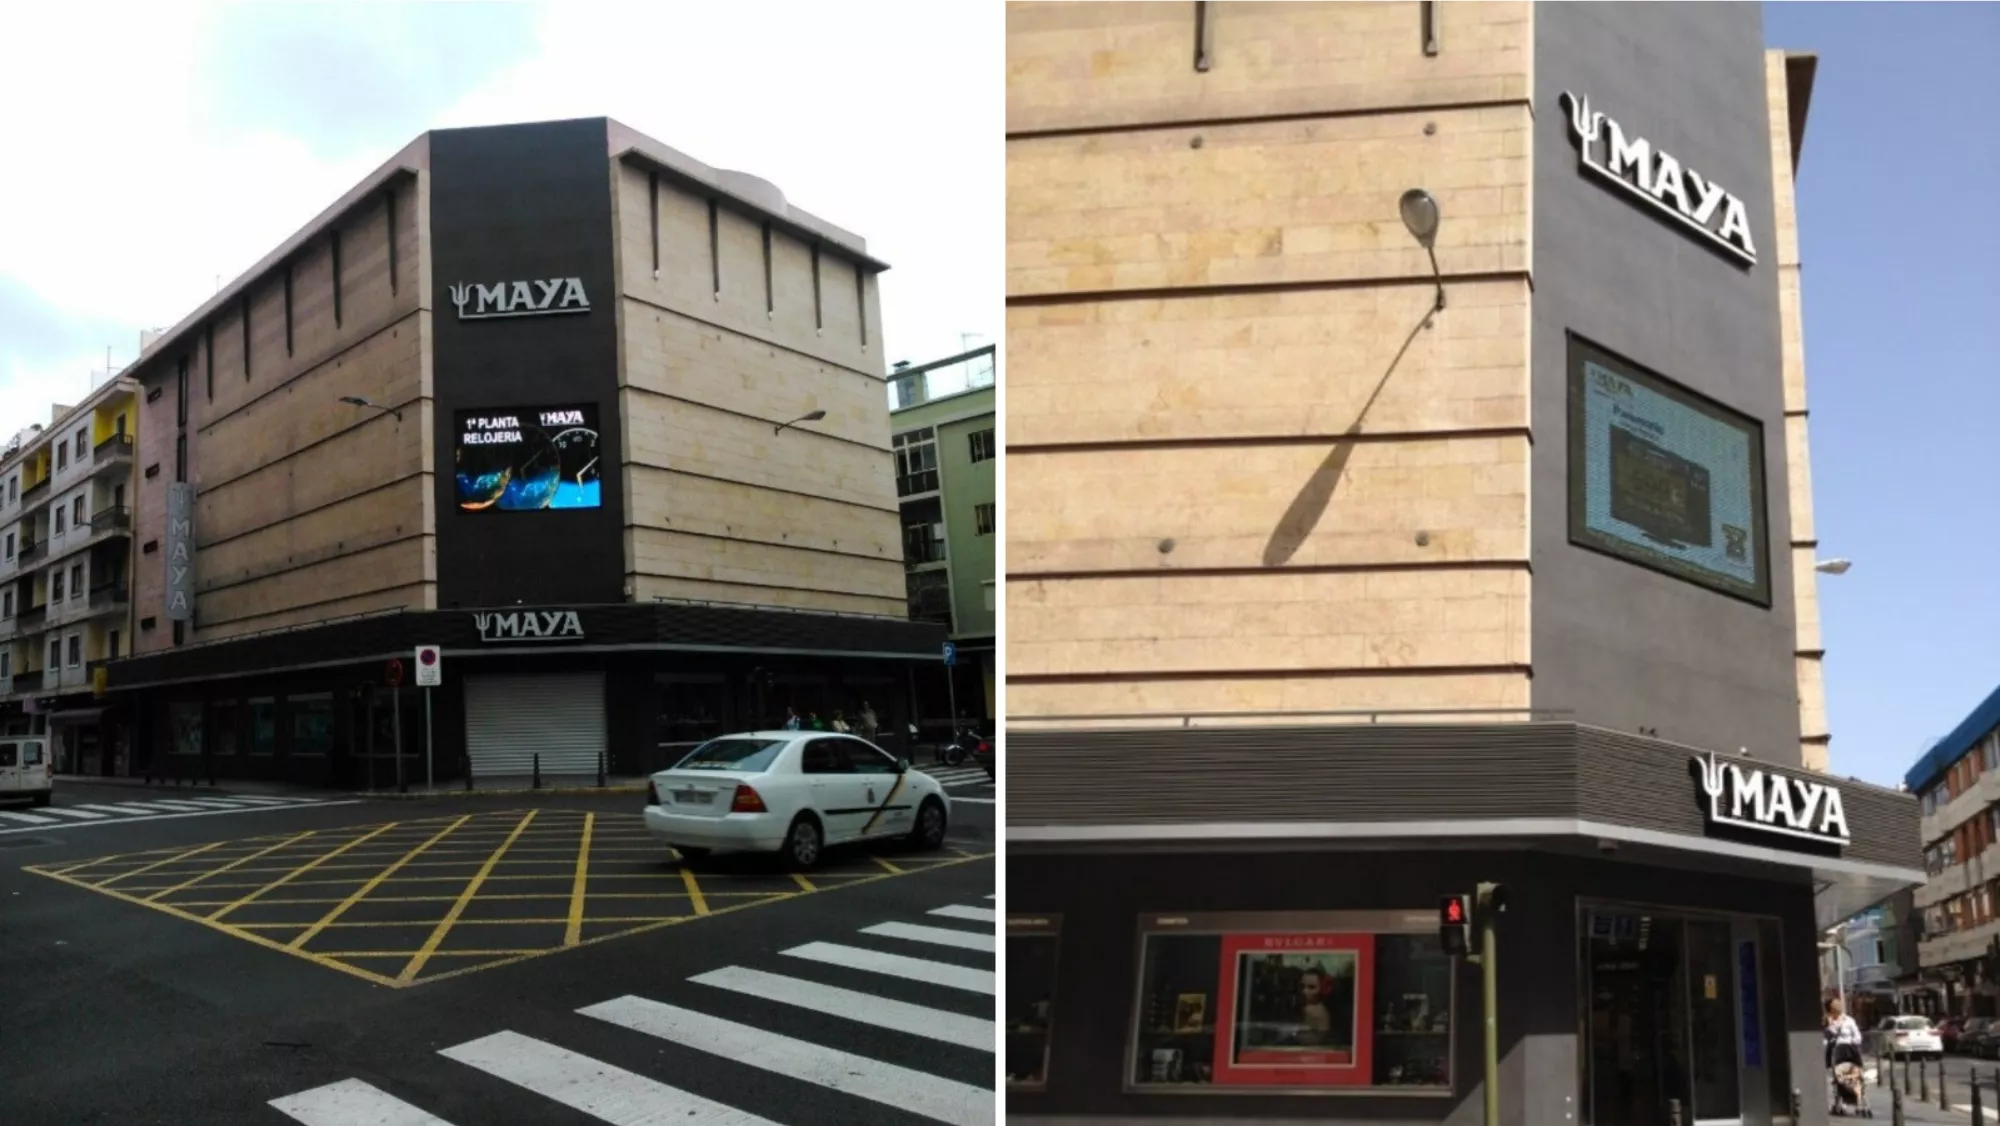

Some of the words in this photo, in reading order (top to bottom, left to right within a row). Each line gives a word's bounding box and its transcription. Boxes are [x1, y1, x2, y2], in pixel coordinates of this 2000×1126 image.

[1607, 117, 1757, 255] MAYA
[475, 277, 590, 312] MAYA
[478, 416, 519, 429] PLANTA
[547, 410, 584, 424] MAYA
[463, 431, 522, 445] RELOJERIA
[171, 517, 190, 610] MAYA
[495, 611, 584, 637] MAYA
[1729, 764, 1850, 837] MAYA
